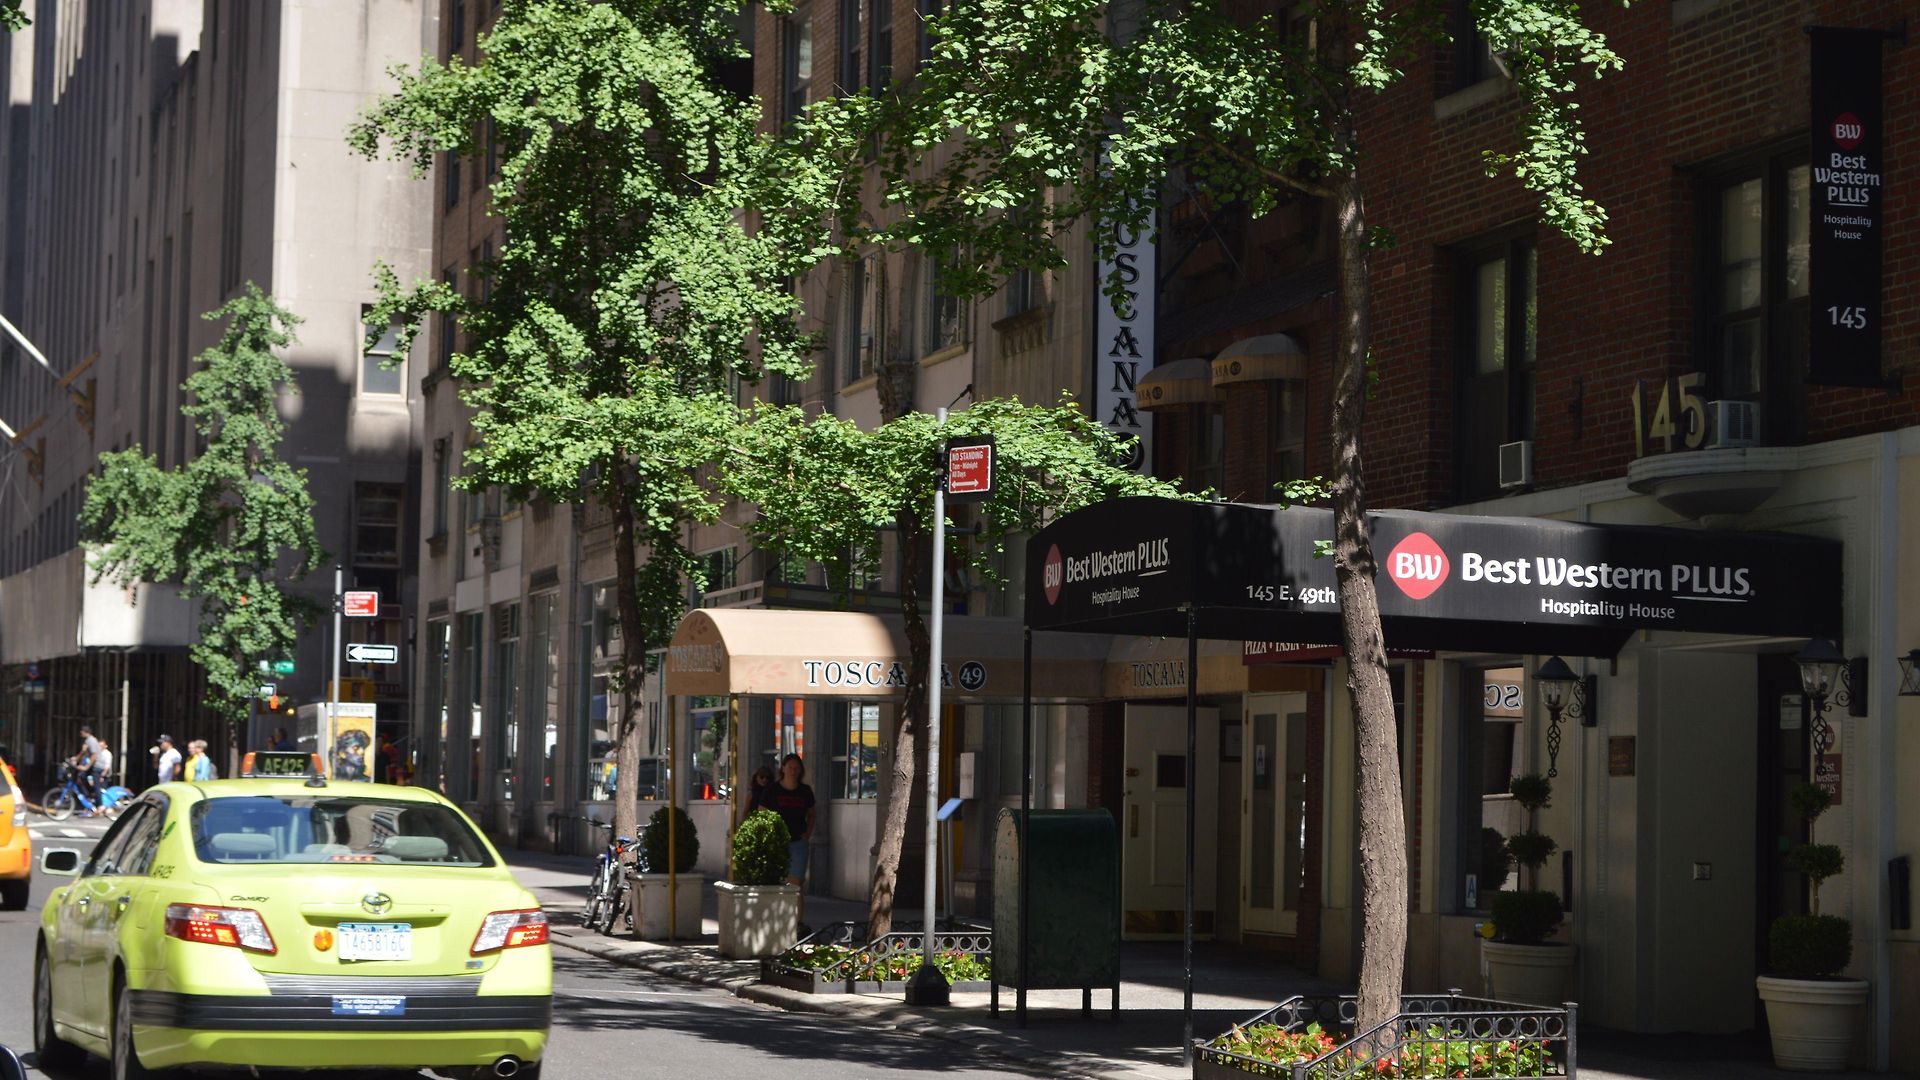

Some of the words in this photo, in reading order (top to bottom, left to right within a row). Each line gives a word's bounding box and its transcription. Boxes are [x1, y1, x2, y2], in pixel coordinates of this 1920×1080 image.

[1835, 123, 1860, 139] BW
[1831, 152, 1867, 169] Best
[1814, 167, 1880, 186] Western
[1827, 185, 1869, 203] PLUS
[1824, 214, 1872, 228] Hospitality
[1834, 229, 1862, 240] House
[1827, 305, 1867, 330] 145
[1632, 371, 1708, 458] 145
[952, 452, 960, 461] NO
[960, 450, 983, 461] STANDING
[1066, 556, 1090, 583] Best
[1091, 550, 1136, 579] Western
[1138, 537, 1169, 570] PLUS
[1395, 552, 1442, 580] BW
[1045, 562, 1061, 588] BW
[1461, 552, 1531, 585] Best
[1536, 557, 1663, 592] Western
[1671, 564, 1752, 596] PLUS
[1092, 587, 1121, 606] Hospitality
[1122, 586, 1140, 600] House
[1246, 585, 1275, 601] 145
[1279, 585, 1294, 601] E.
[1298, 587, 1336, 604] 49th
[1541, 598, 1625, 620] Hospitality
[1629, 603, 1675, 619] House
[803, 660, 955, 688] TOSCAA
[959, 664, 985, 688] 49
[1132, 661, 1186, 687] TOSCANA
[263, 757, 304, 774] AF425
[1467, 877, 1475, 899] A
